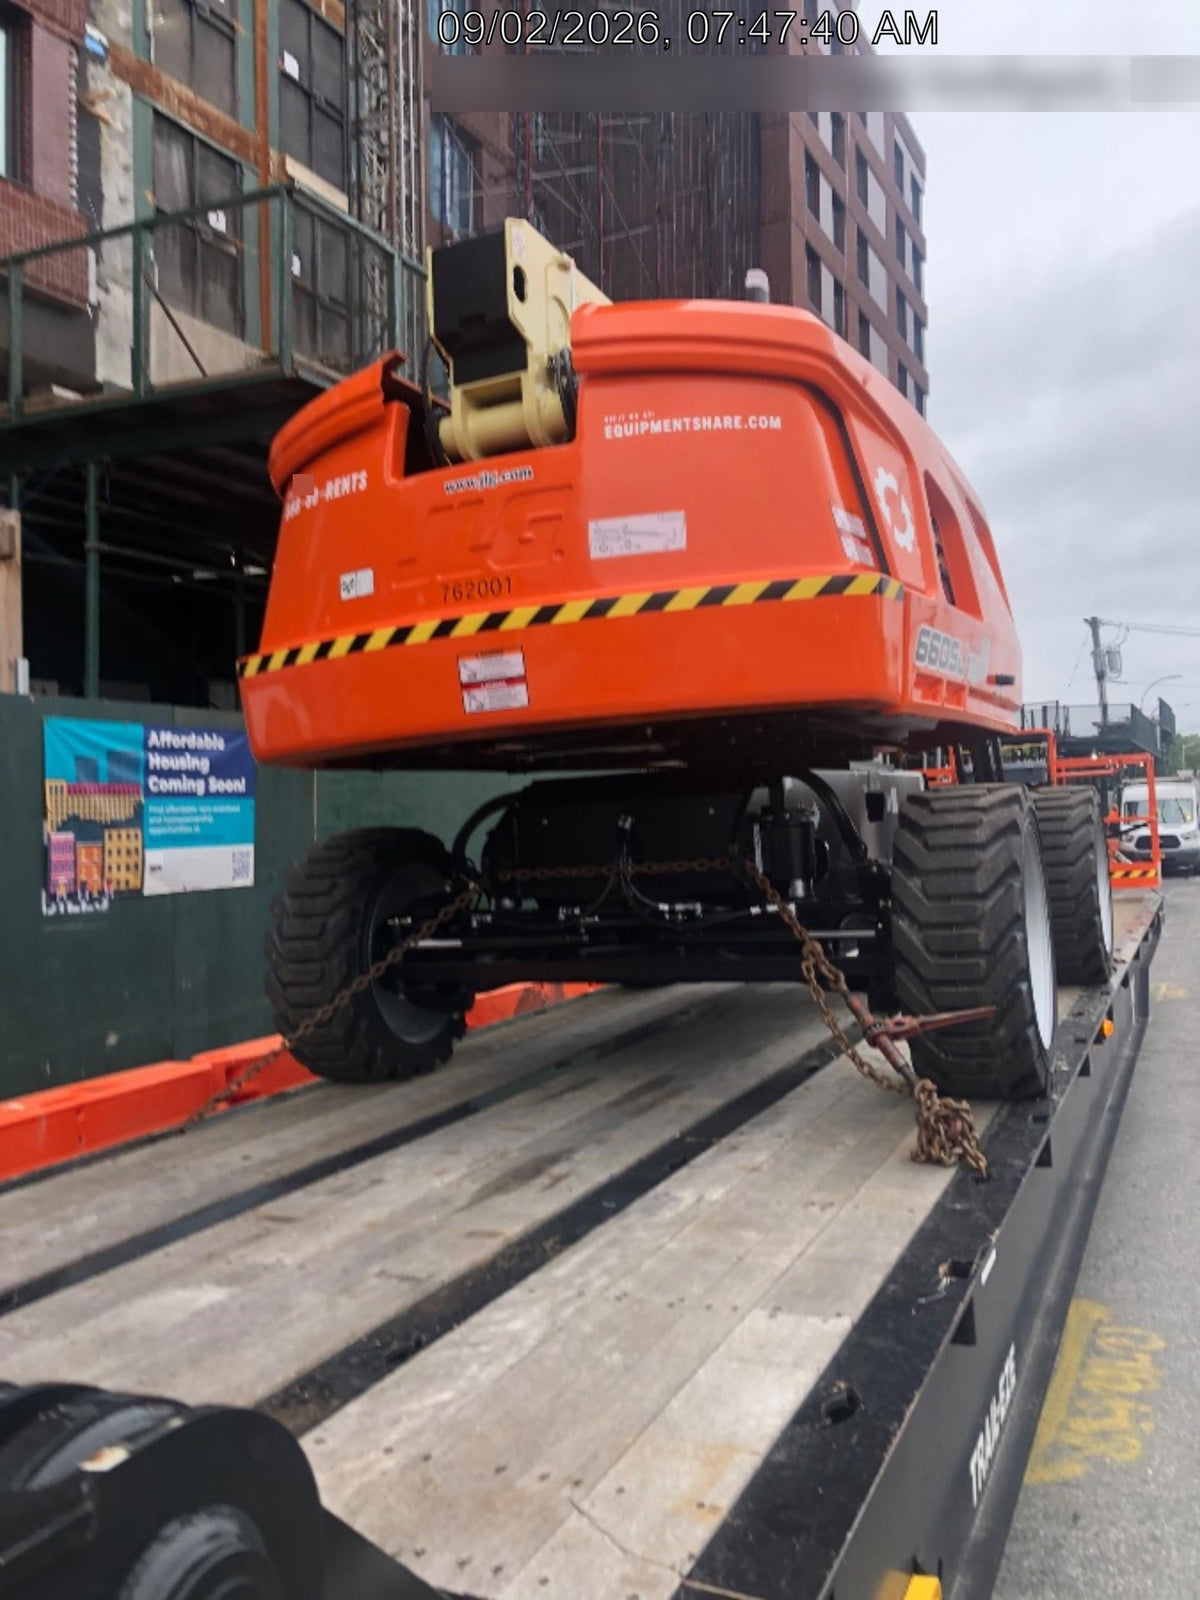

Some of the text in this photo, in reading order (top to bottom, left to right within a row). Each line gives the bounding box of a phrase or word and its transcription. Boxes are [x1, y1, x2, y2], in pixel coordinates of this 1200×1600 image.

[604, 415, 782, 440] EQUIPMENTSHARE.COM
[441, 576, 513, 604] 762001
[148, 730, 225, 751] Affordable
[149, 752, 210, 774] Housing
[148, 774, 246, 796] Coming Soon!
